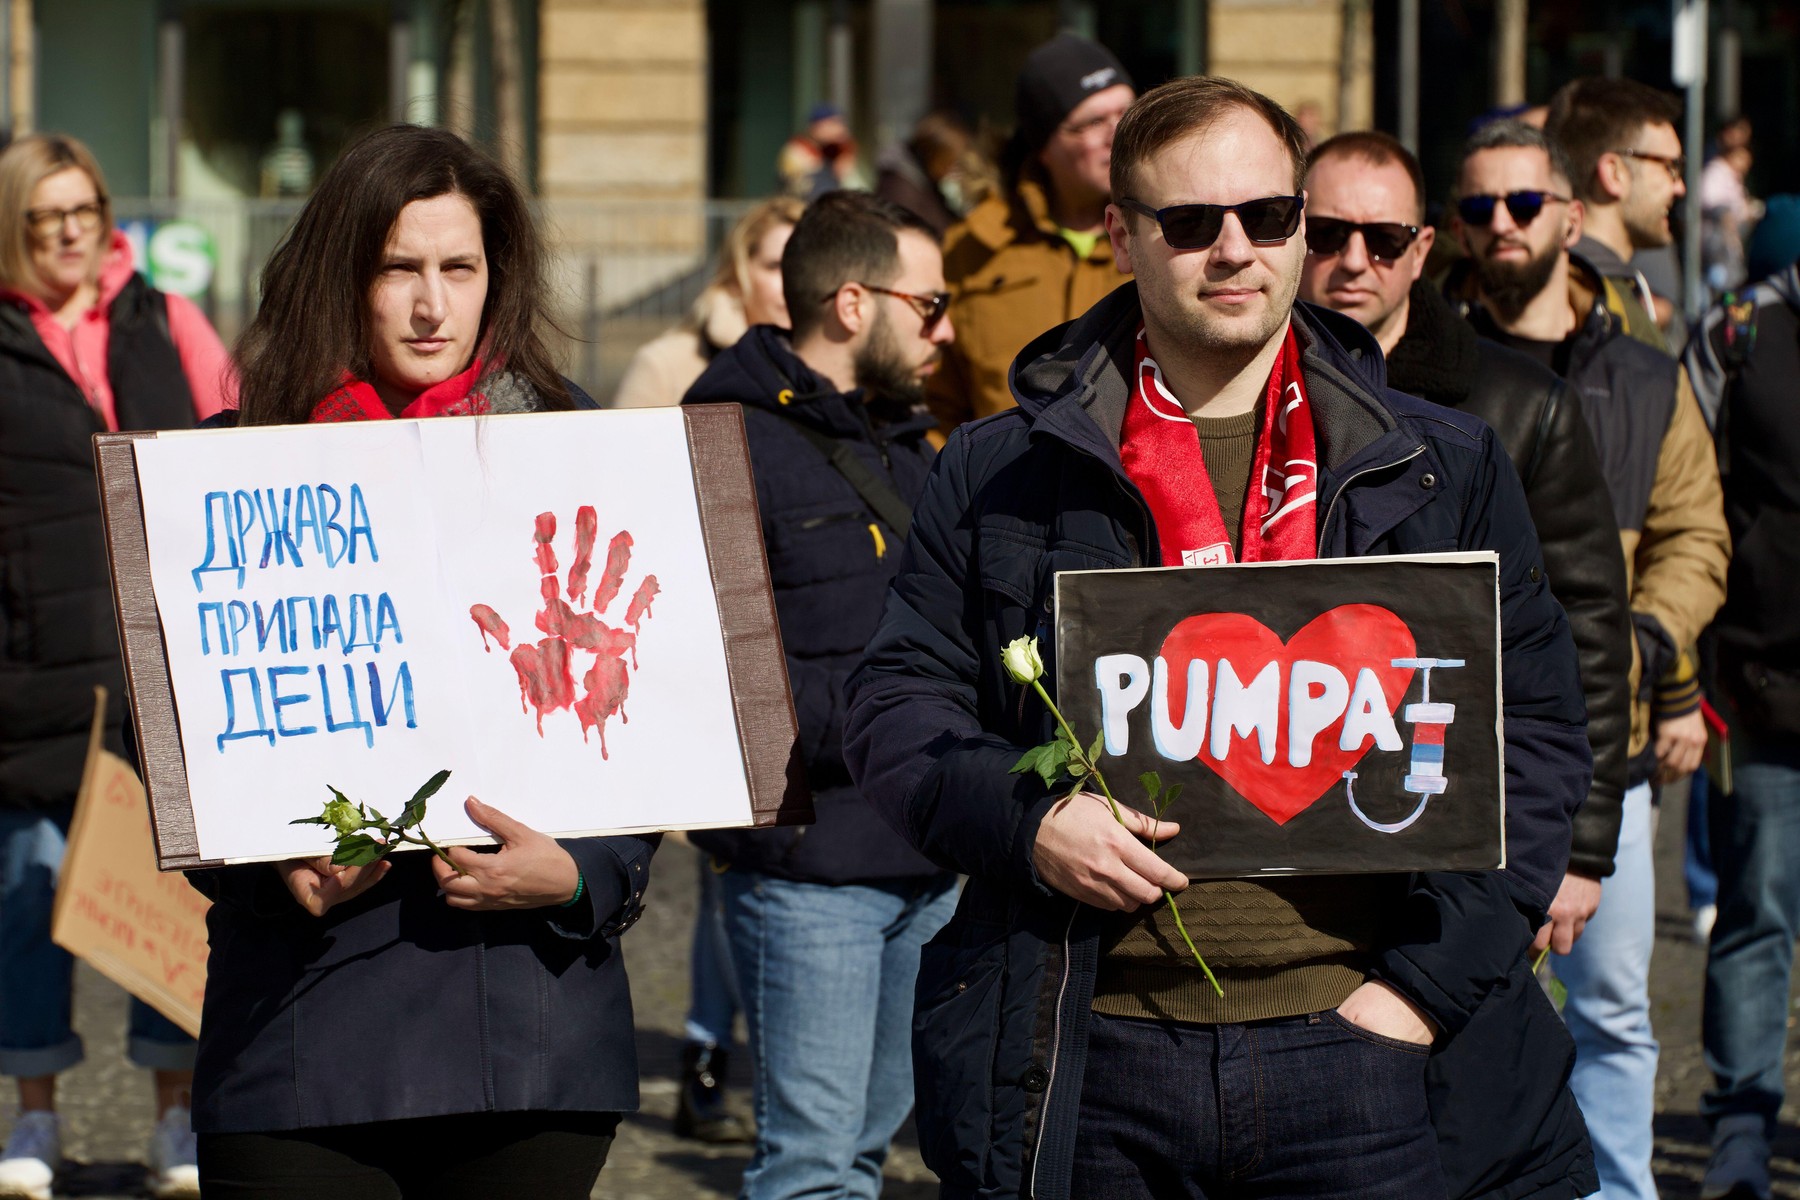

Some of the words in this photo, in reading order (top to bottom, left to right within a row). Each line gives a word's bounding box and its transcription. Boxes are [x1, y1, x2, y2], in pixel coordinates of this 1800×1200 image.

[152, 223, 211, 297] S
[191, 483, 379, 593] ДРЖАВА
[198, 592, 403, 656] ПРИПАДА
[217, 661, 418, 754] ДЕЦИ
[1095, 653, 1404, 768] PUMPA
